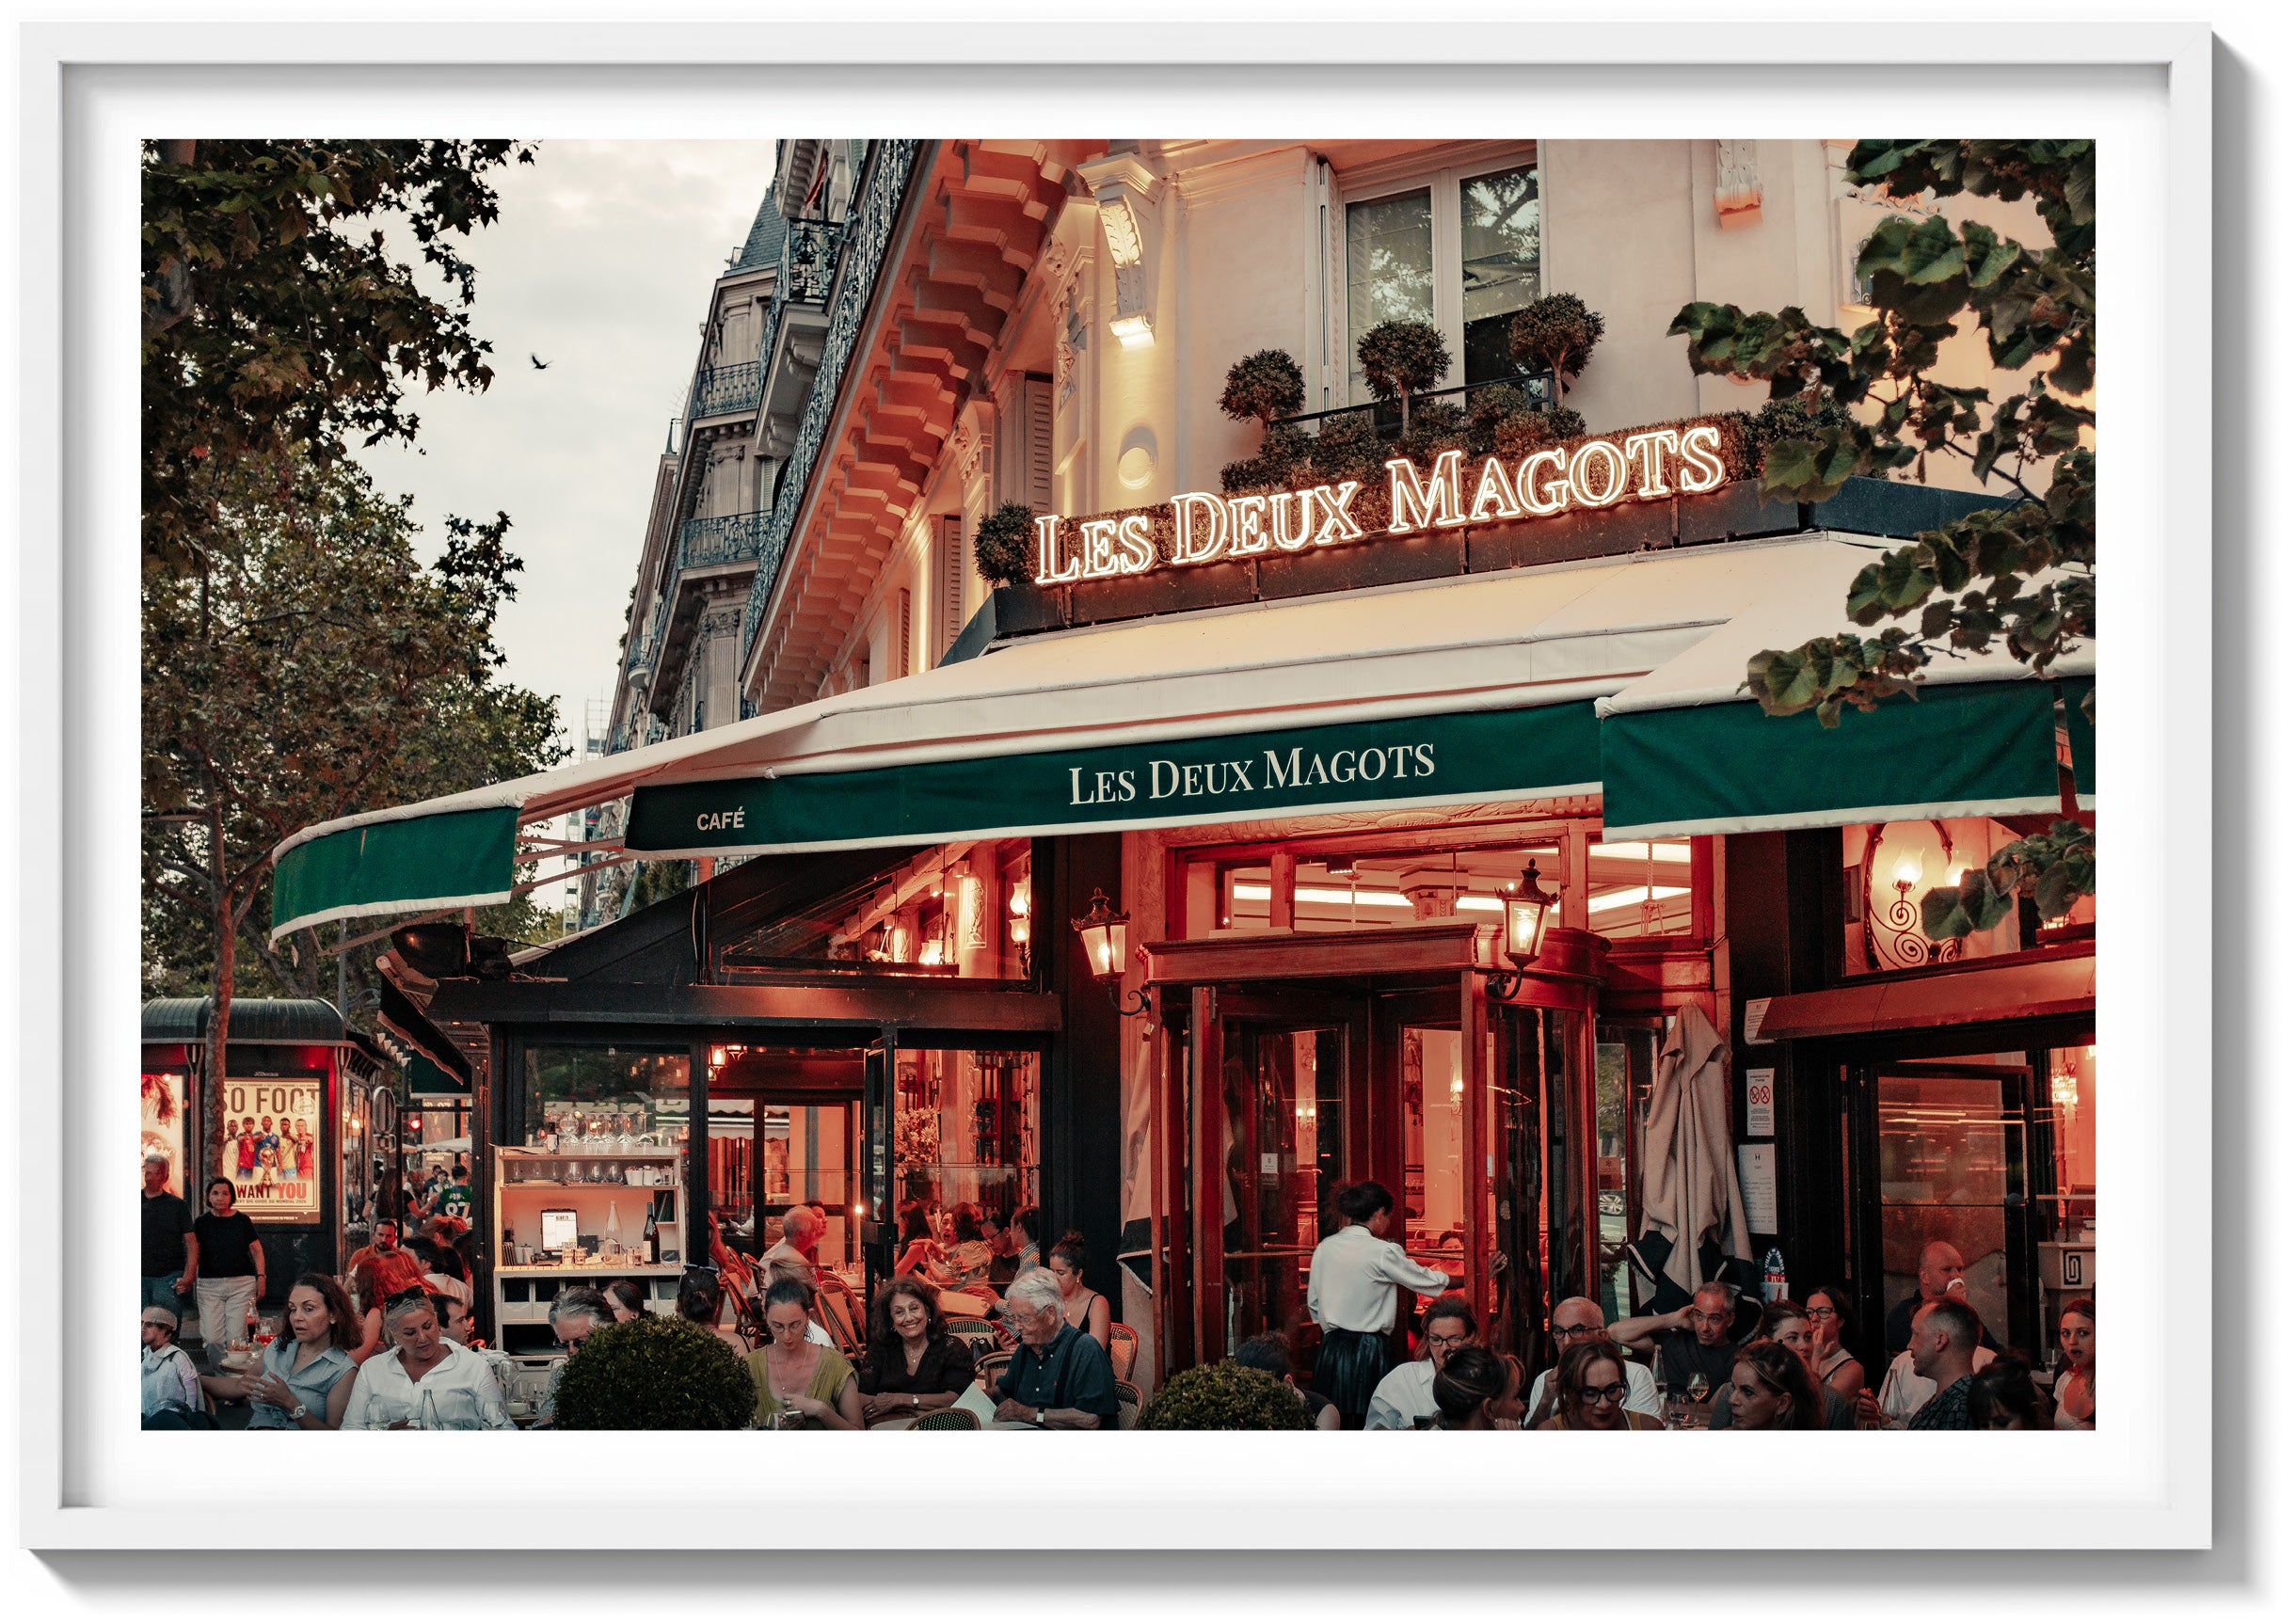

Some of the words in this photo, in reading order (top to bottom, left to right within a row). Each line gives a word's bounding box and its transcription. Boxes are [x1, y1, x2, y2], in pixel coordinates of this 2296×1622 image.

[1034, 514, 1154, 584] LES
[1170, 481, 1363, 565] DEUX
[1385, 426, 1724, 533] MAGOTS
[1068, 767, 1136, 805] LES
[1148, 759, 1254, 800] DEUX
[1263, 743, 1435, 789] MAGOTS
[696, 805, 745, 831] CAFÉ
[236, 1185, 271, 1199] WANT
[276, 1183, 307, 1200] YOU
